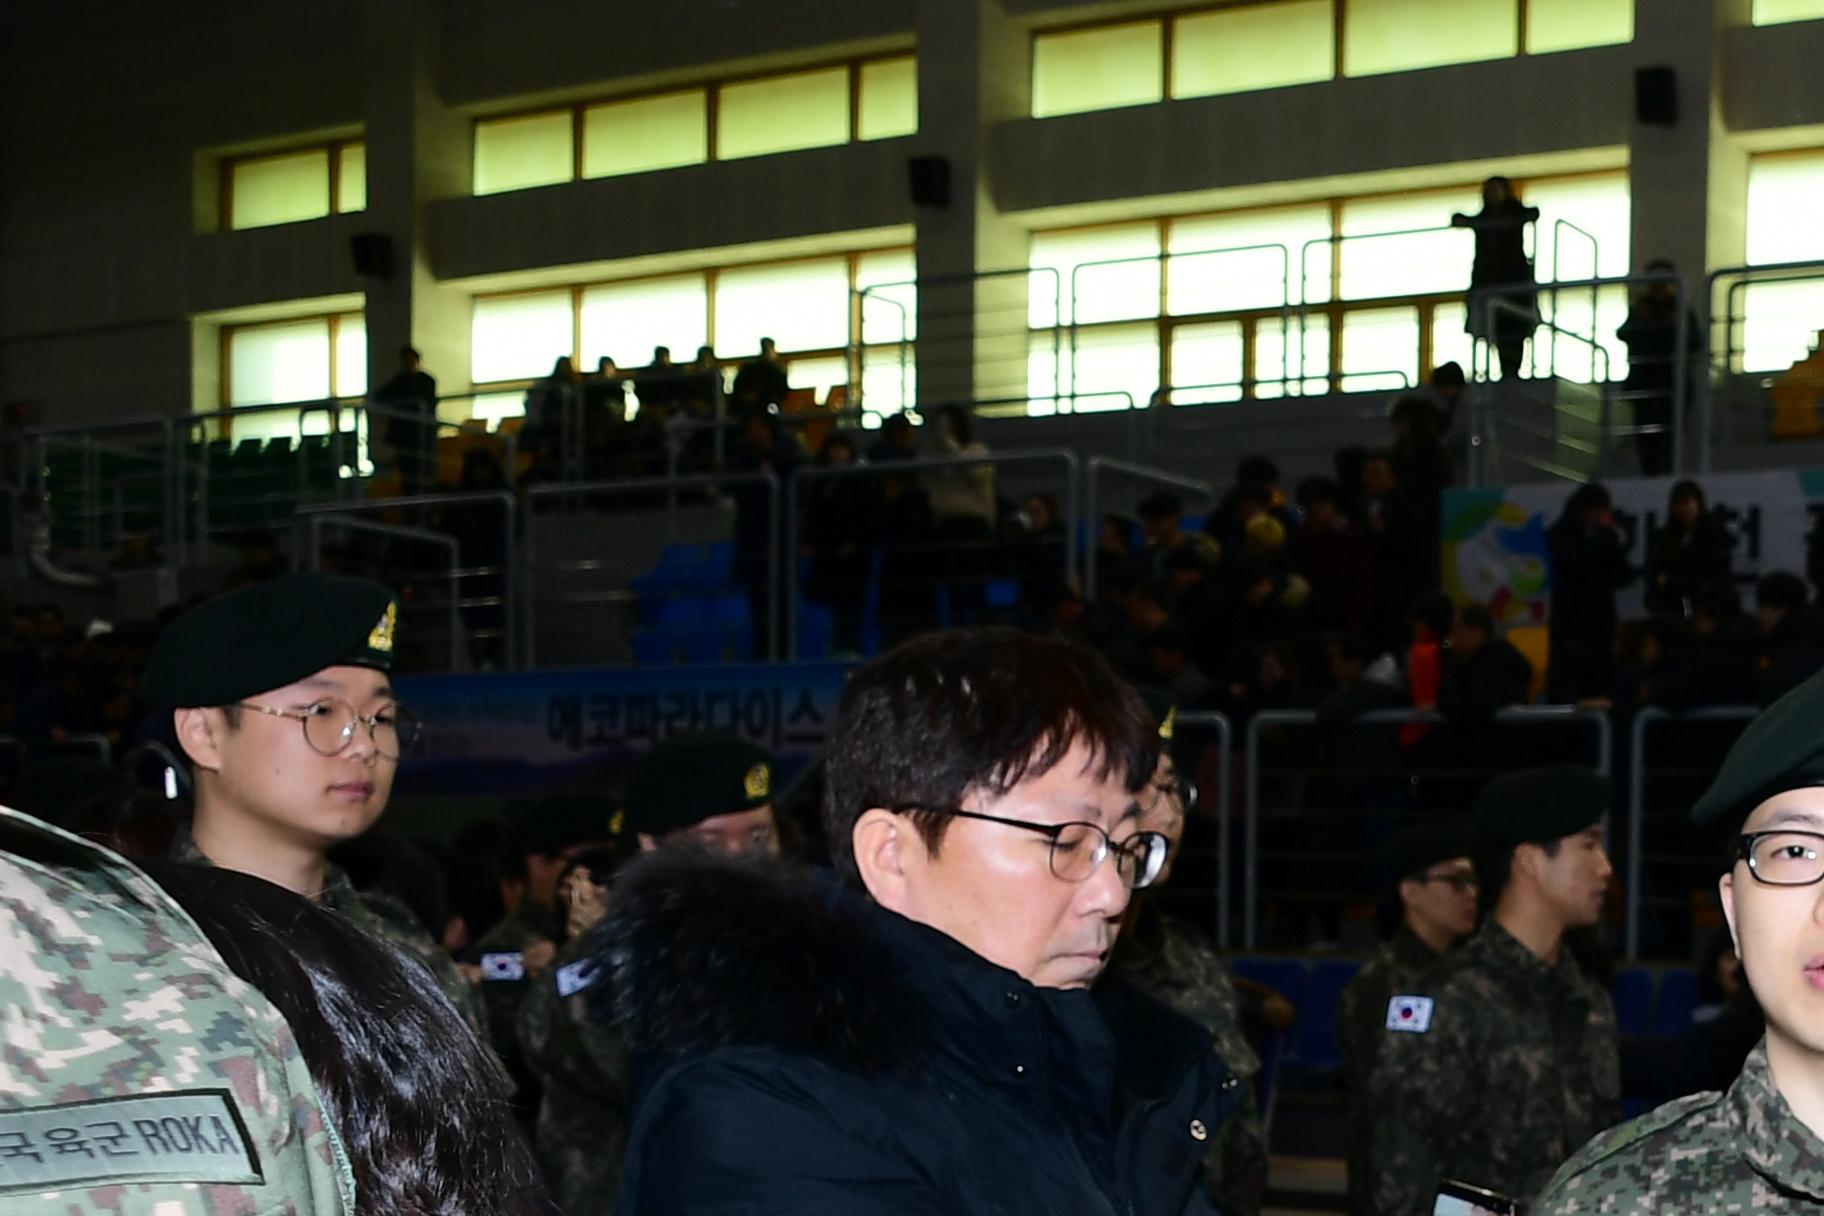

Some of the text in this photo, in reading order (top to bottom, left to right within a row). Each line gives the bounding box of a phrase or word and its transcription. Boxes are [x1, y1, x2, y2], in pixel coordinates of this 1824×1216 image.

[546, 686, 823, 750] 에코파라다이스
[0, 1131, 44, 1165] 국
[130, 1115, 240, 1156] ROKA
